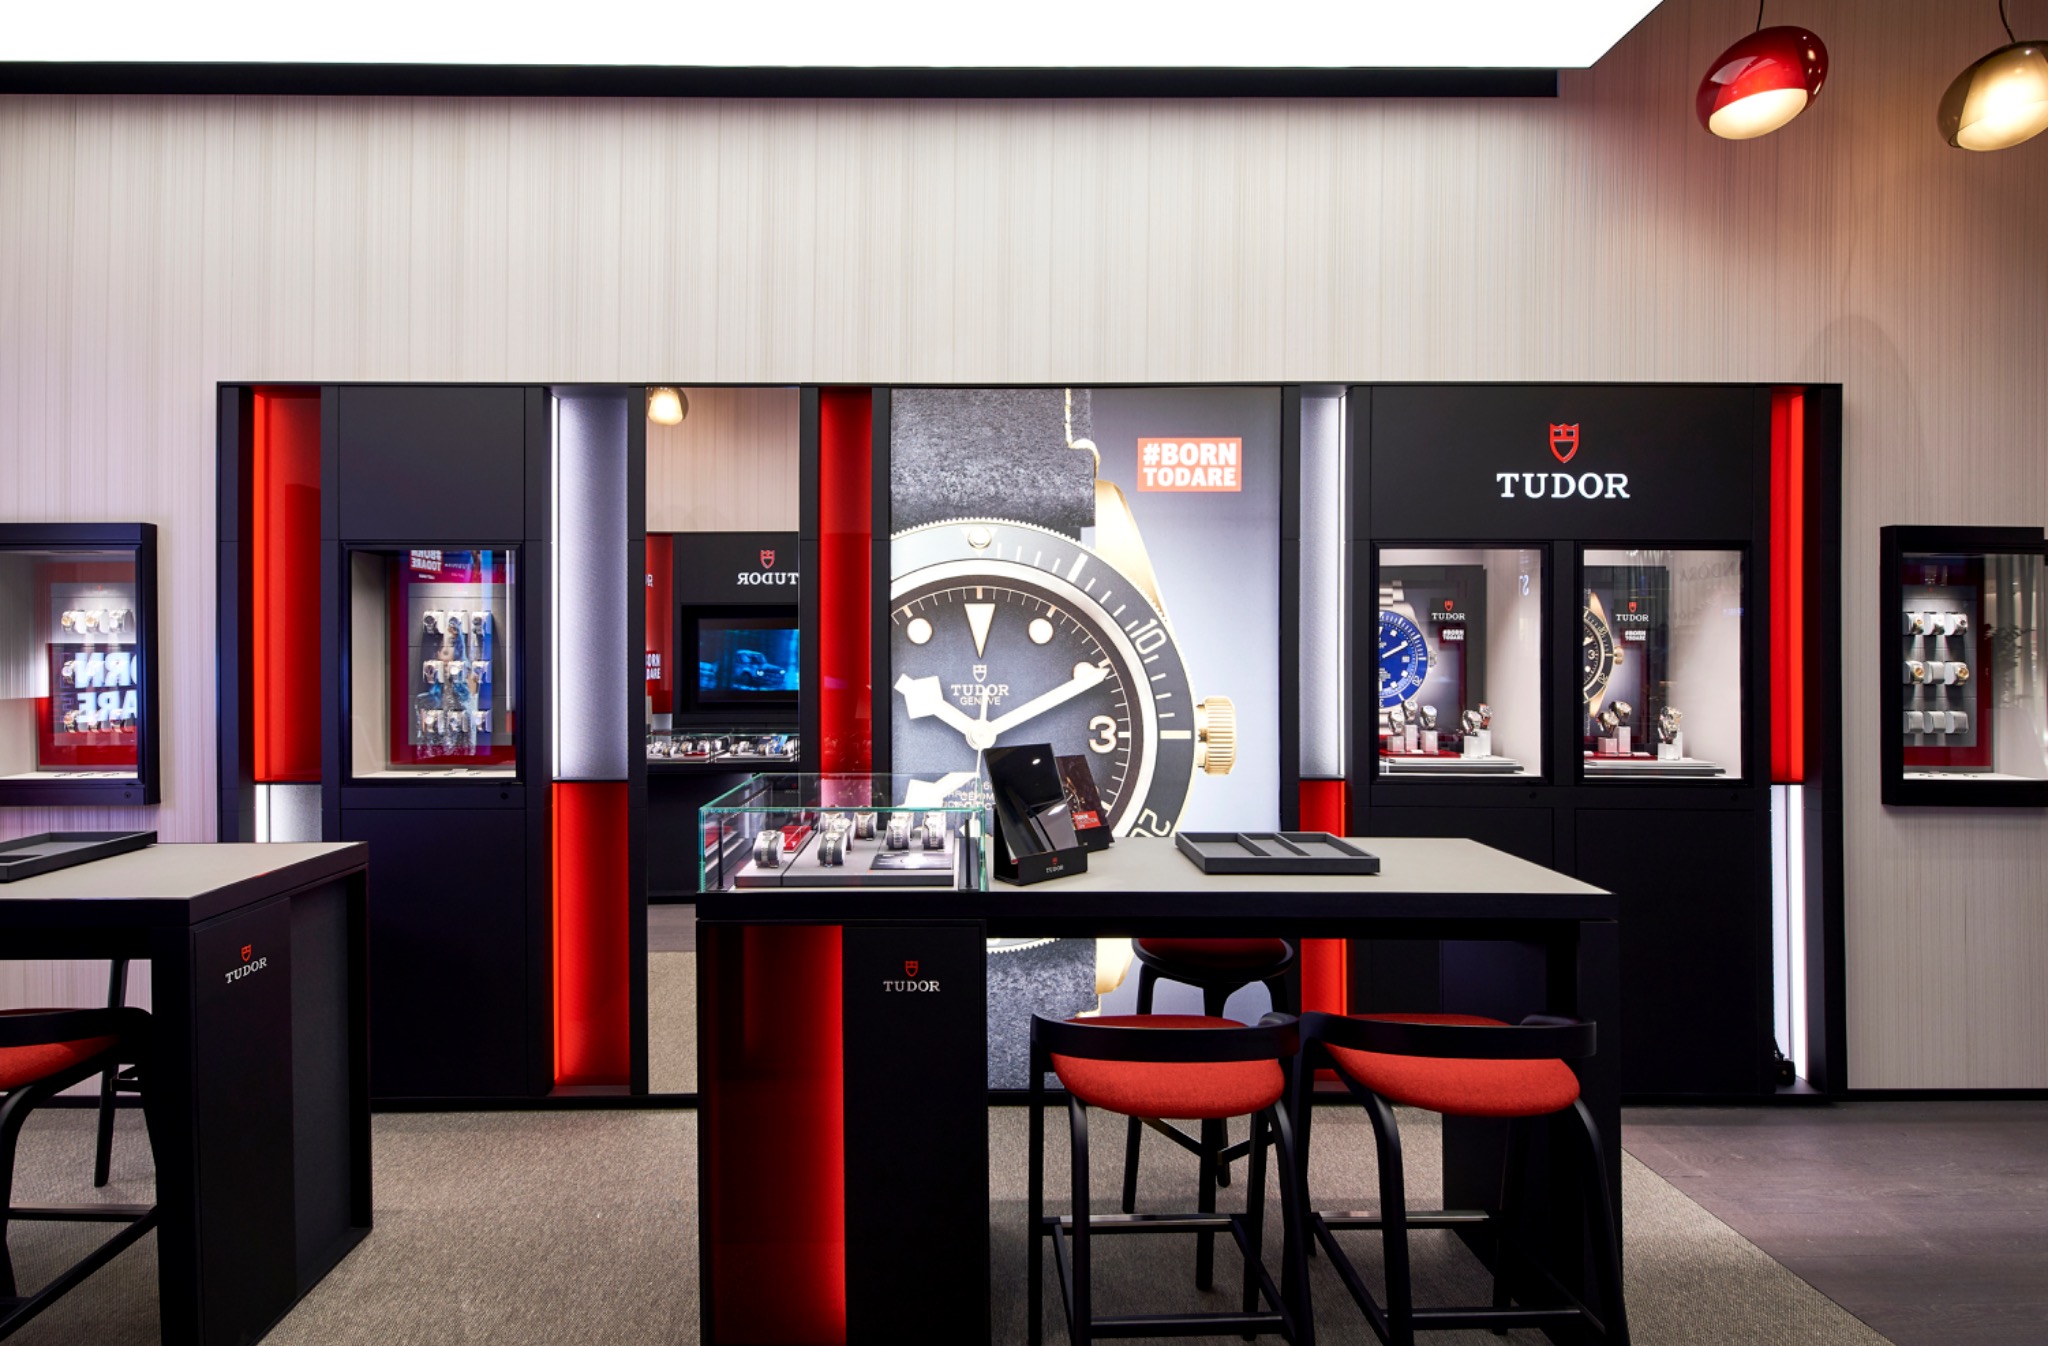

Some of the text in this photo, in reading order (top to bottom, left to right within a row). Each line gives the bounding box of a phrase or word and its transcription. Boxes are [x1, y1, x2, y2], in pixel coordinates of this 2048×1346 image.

[1143, 442, 1237, 466] #BORN
[1143, 467, 1236, 487] TODARE
[1496, 472, 1631, 499] TUDOR
[1431, 612, 1466, 621] TUDOR
[1615, 613, 1650, 622] TUDOR
[1137, 619, 1168, 655] 10
[950, 684, 1009, 696] TUDOR
[960, 697, 1001, 705] GENVE
[1088, 715, 1118, 754] 3
[224, 956, 267, 984] TUDOR
[883, 980, 941, 992] TUDOR
